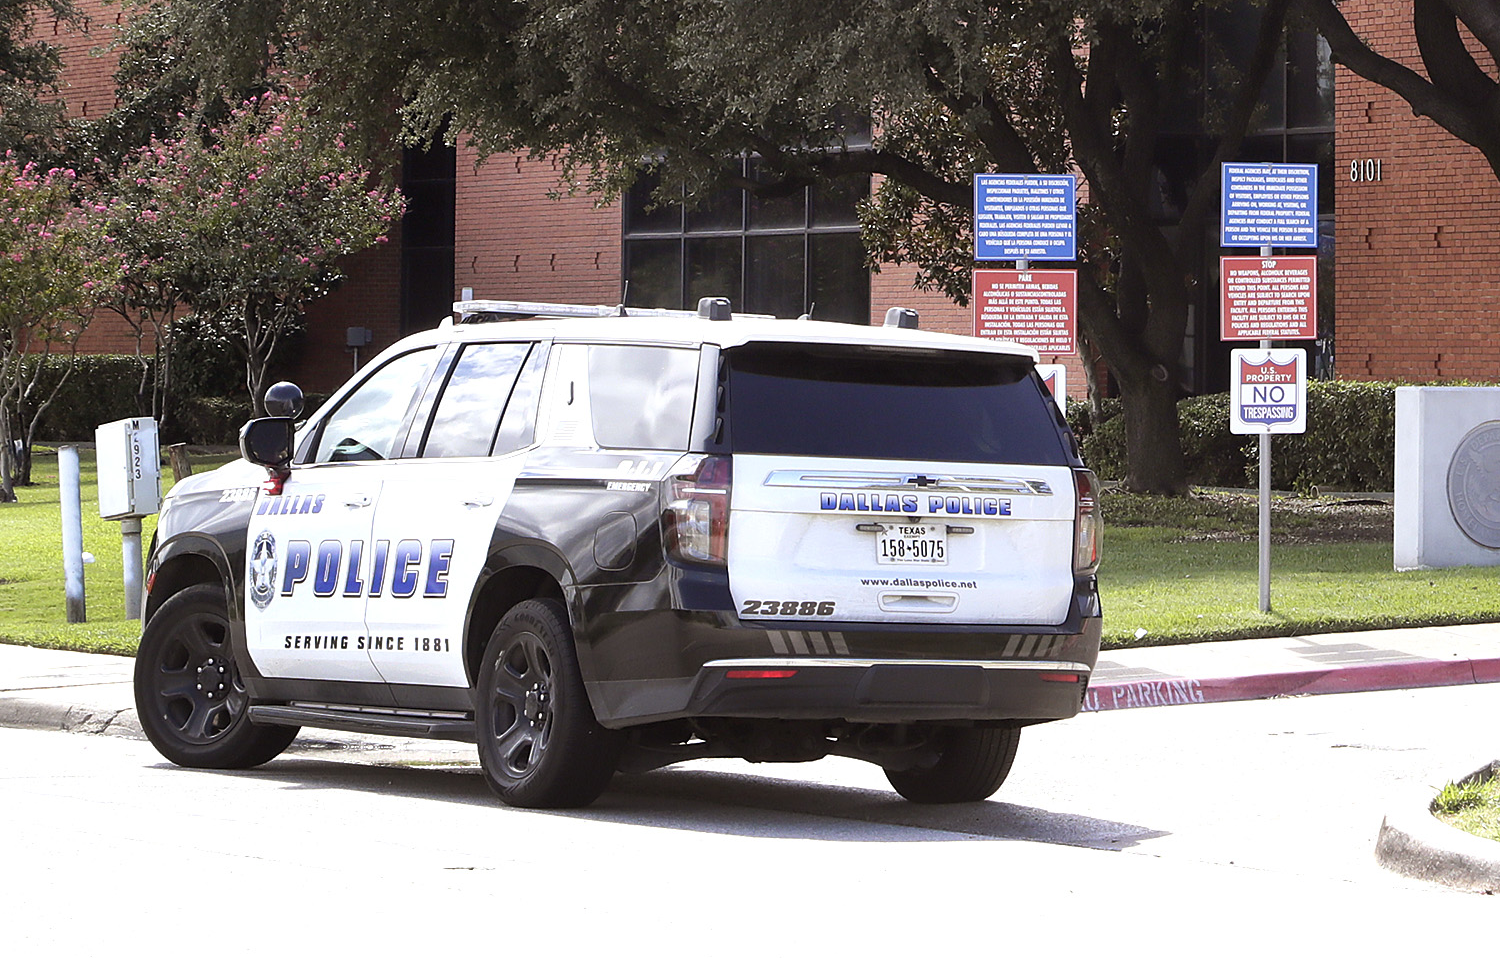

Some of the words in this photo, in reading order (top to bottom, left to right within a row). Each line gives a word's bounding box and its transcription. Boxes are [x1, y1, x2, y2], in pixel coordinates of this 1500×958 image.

[1350, 158, 1381, 182] 8101
[1261, 260, 1277, 269] STOP
[1018, 274, 1032, 282] PARE
[1246, 374, 1292, 382] PROPERTY
[1254, 386, 1285, 403] NO
[1243, 406, 1294, 419] TRESPASSING
[606, 482, 652, 492] EMERGENCY
[257, 494, 326, 516] DALLAS
[820, 492, 918, 512] DALLAS
[928, 496, 1012, 516] POLICE
[899, 527, 926, 535] TEXAS
[280, 539, 455, 598] POLICE
[860, 577, 978, 589] www.dallaspolice.net
[740, 600, 836, 616] 23886
[284, 636, 348, 650] SERVING
[357, 637, 404, 650] SINCE
[414, 638, 450, 652] 1881
[1111, 679, 1204, 709] PARKING
